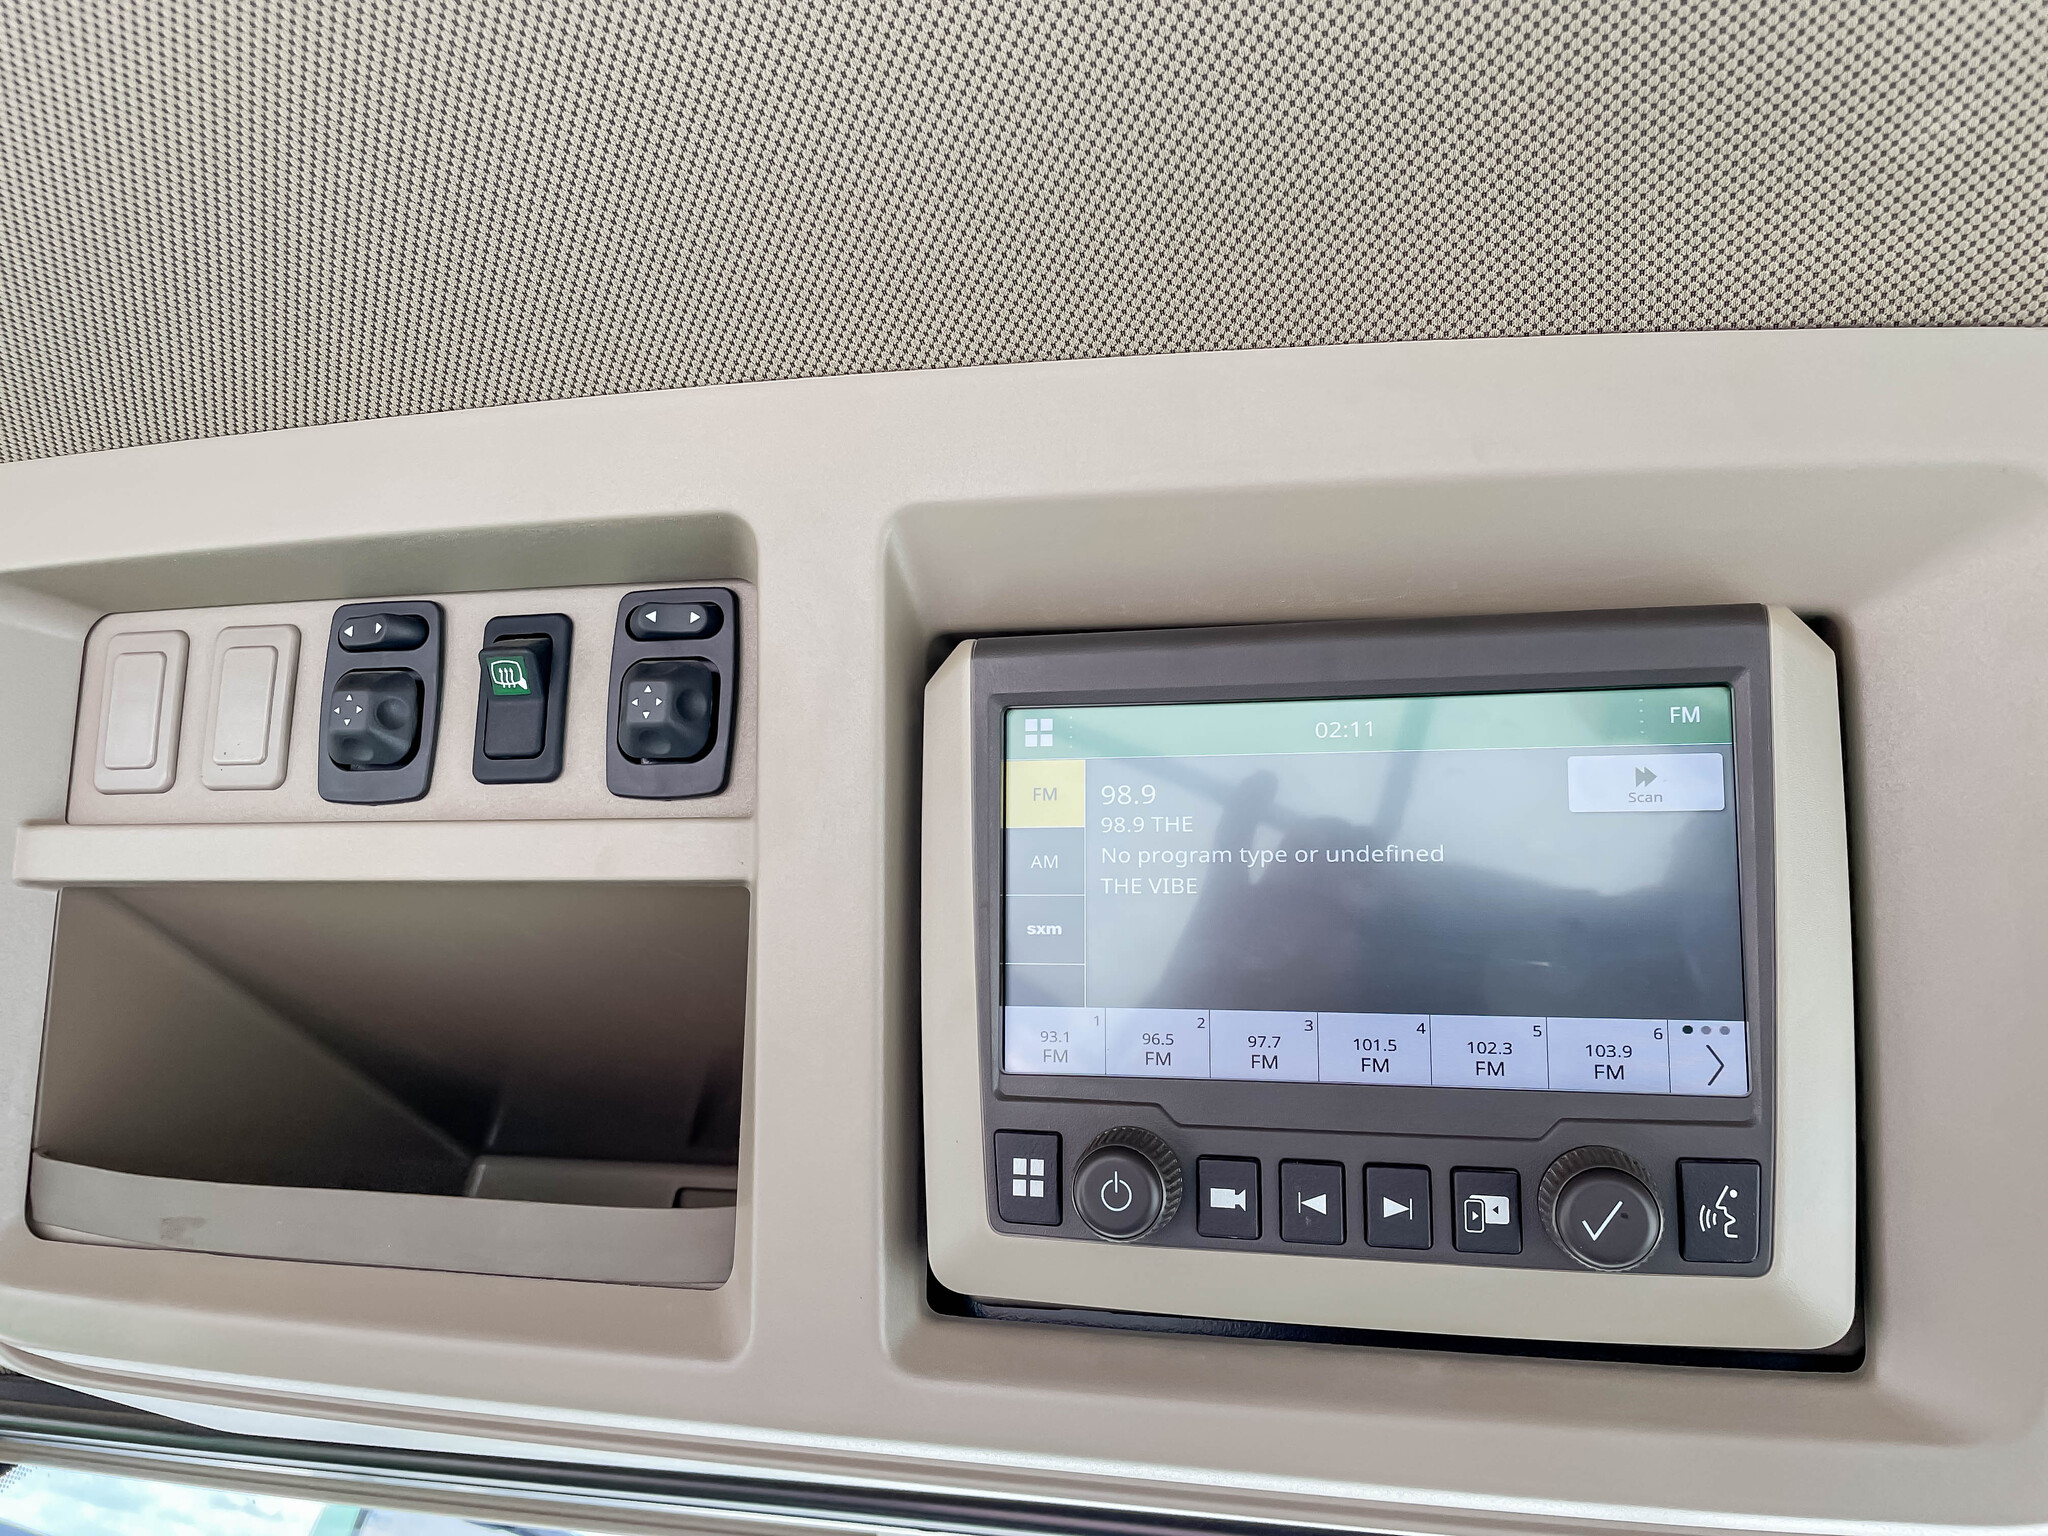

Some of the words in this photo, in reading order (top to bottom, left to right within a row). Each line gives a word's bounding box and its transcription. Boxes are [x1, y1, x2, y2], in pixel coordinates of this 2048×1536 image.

[1670, 705, 1701, 724] FM
[1315, 720, 1374, 739] 02:11
[1033, 787, 1058, 802] FM
[1101, 784, 1156, 806] 98.9
[1628, 791, 1663, 804] Scan
[1101, 816, 1145, 833] 98.9
[1151, 815, 1193, 833] THE
[1030, 854, 1059, 869] AM
[1101, 847, 1132, 864] No
[1138, 849, 1232, 868] program
[1240, 847, 1287, 868] type
[1295, 849, 1319, 863] or
[1326, 844, 1445, 863] undefined
[1100, 877, 1142, 894] THE
[1148, 877, 1197, 894] VIBE
[1026, 924, 1063, 936] sxm
[1093, 1015, 1100, 1027] 1
[1196, 1017, 1206, 1029] 2
[1304, 1019, 1314, 1032] 3
[1416, 1022, 1426, 1035] 4
[1533, 1025, 1542, 1038] 5
[1653, 1027, 1664, 1040] 6
[1040, 1030, 1070, 1043] 93.1
[1142, 1032, 1175, 1046] 96.5
[1247, 1035, 1281, 1049] 97.7
[1353, 1038, 1397, 1052] 101.5
[1467, 1041, 1513, 1055] 102.3
[1585, 1044, 1633, 1058] 103.9
[1043, 1049, 1069, 1064] FM
[1145, 1051, 1172, 1067] FM
[1251, 1054, 1279, 1070] FM
[1361, 1057, 1390, 1073] FM
[1475, 1061, 1505, 1077] FM
[1594, 1064, 1625, 1080] FM
